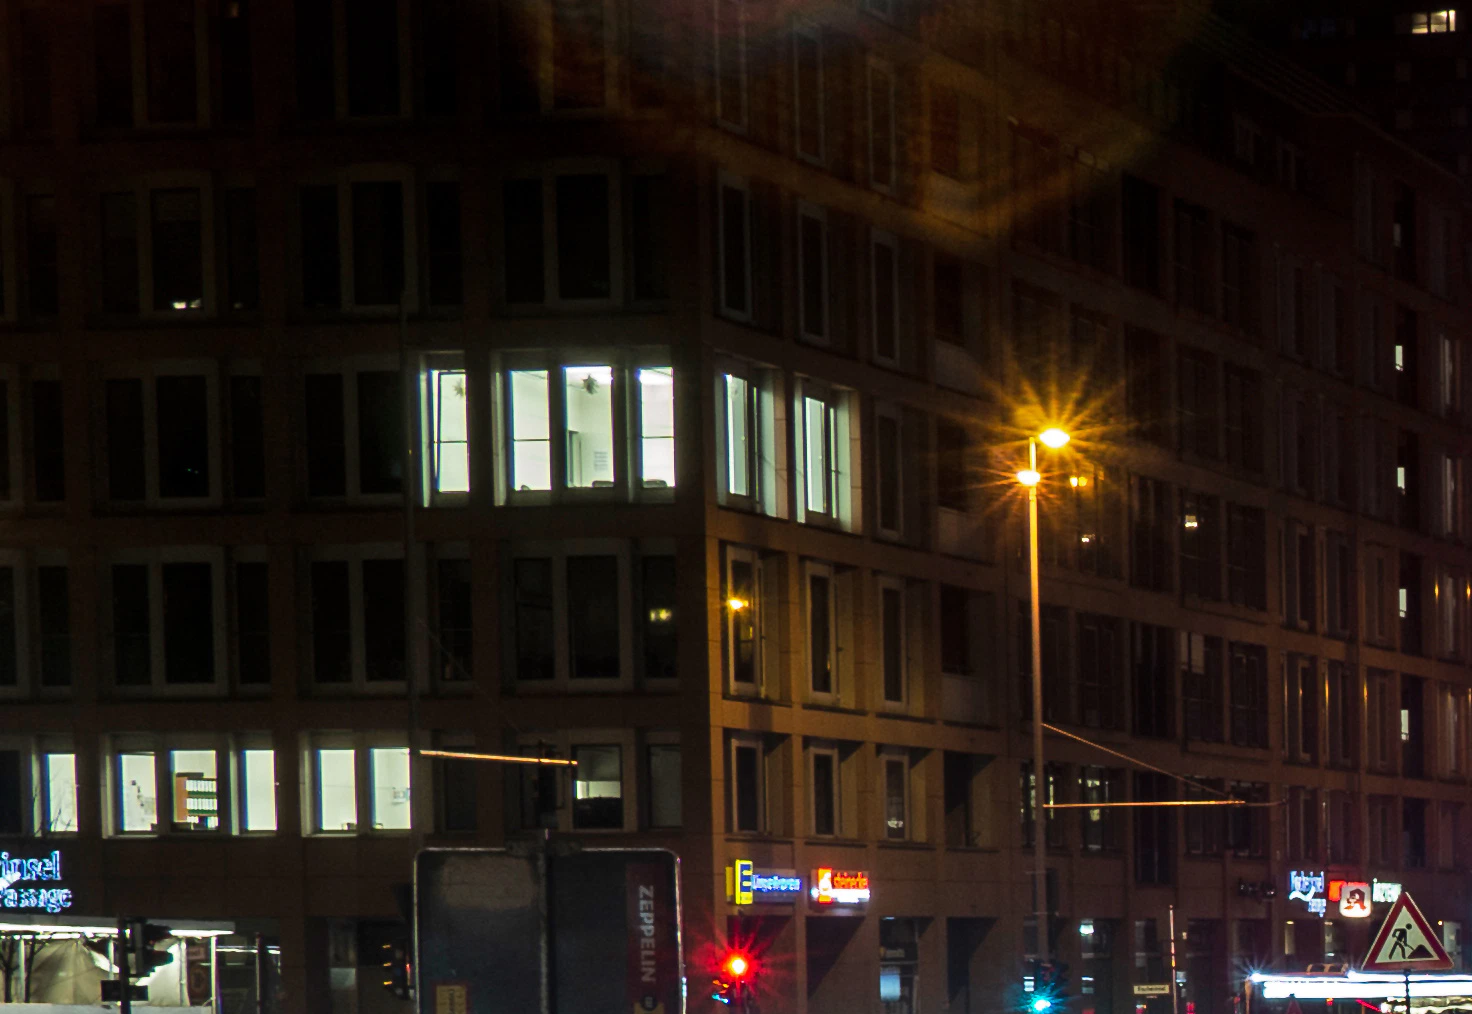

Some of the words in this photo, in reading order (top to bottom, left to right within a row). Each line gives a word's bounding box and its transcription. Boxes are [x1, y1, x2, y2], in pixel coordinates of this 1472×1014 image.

[0, 850, 62, 880] insel
[0, 887, 73, 913] assage
[638, 884, 657, 983] ZEPPELIN
